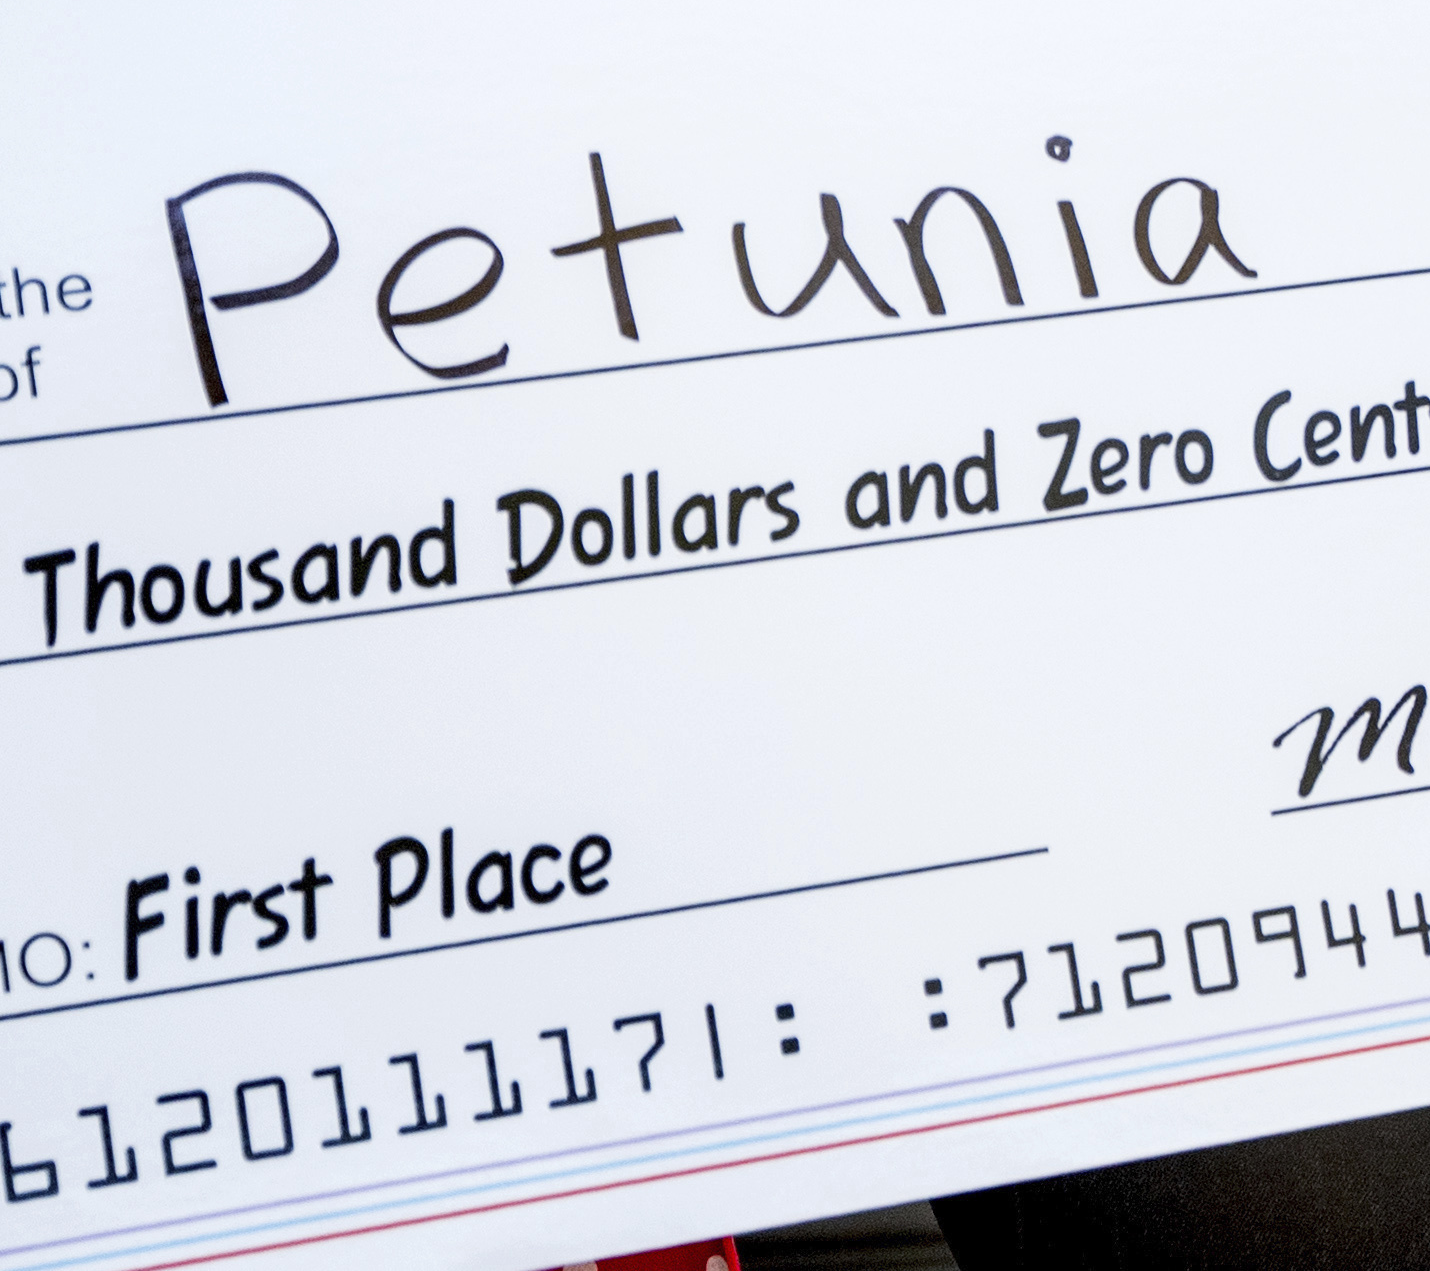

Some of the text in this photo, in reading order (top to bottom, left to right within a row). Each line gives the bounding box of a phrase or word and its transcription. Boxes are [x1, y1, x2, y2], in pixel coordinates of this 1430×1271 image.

[0, 267, 93, 320] the
[165, 135, 1259, 409] Petunia
[22, 497, 458, 648] Thousand
[495, 469, 801, 589] Dollars
[844, 428, 1000, 530] and
[1036, 417, 1215, 513] Zero
[0, 826, 613, 993] O: First Place
